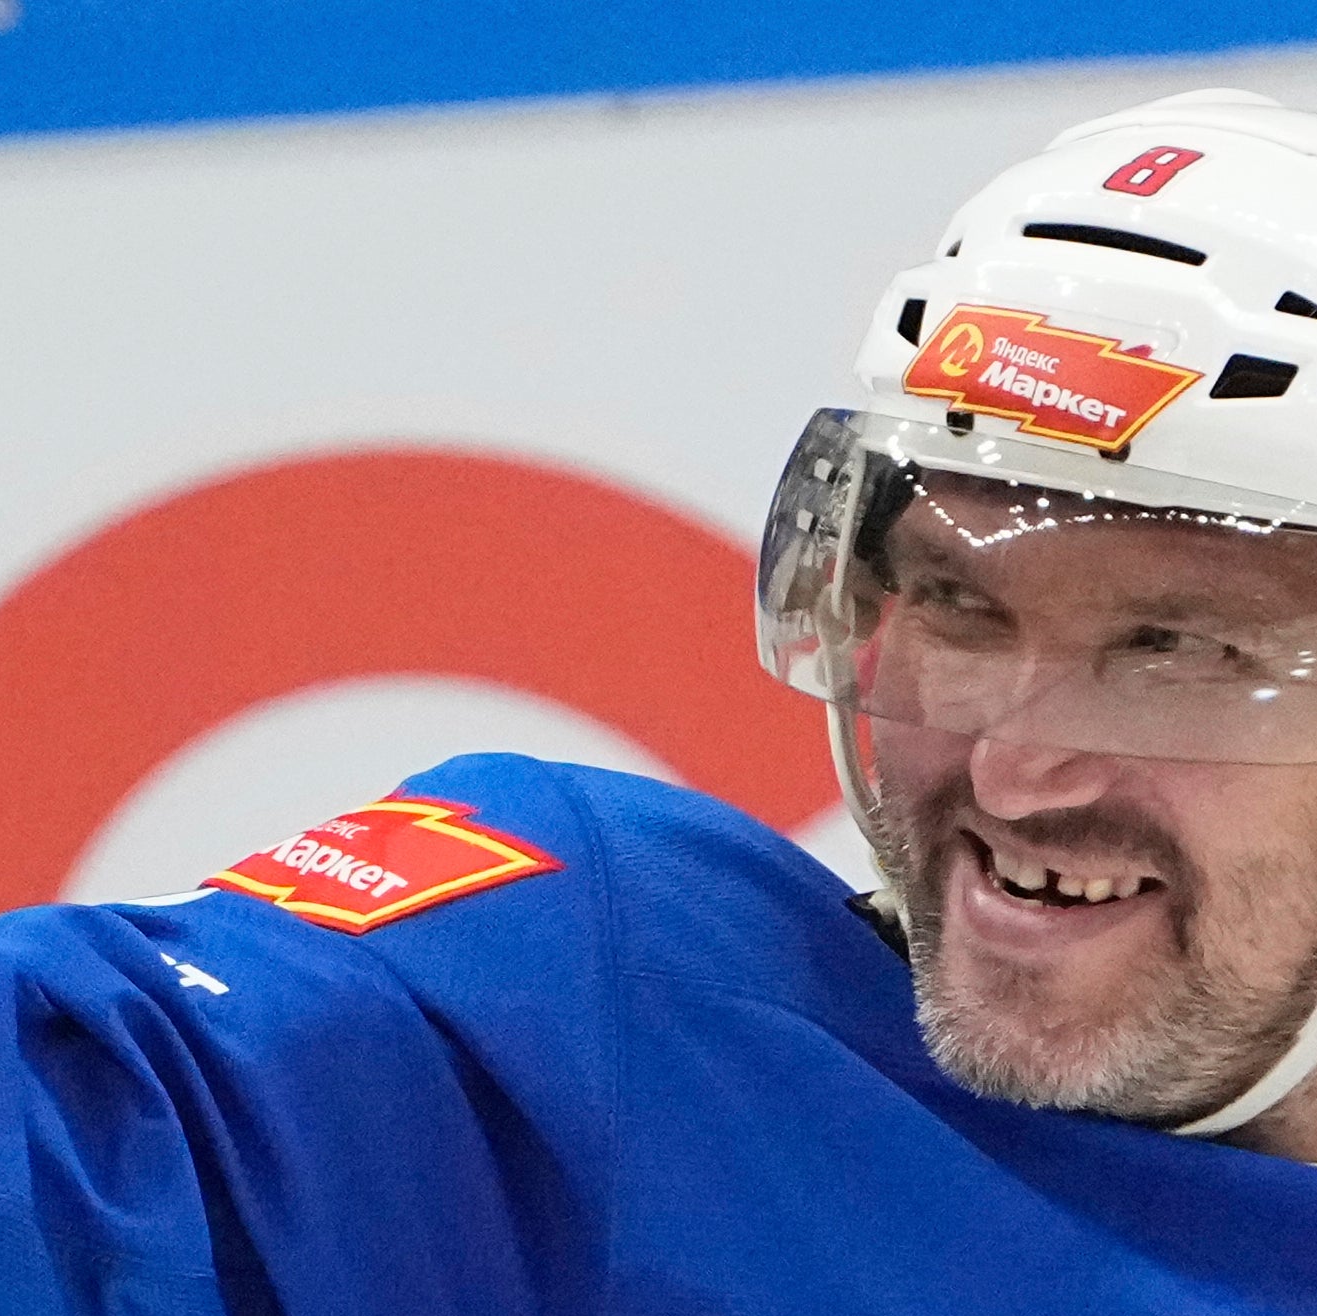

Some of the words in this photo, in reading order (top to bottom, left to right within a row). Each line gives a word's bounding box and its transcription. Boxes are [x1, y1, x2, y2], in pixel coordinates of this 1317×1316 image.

[1102, 145, 1205, 197] 8
[991, 336, 1061, 374] Яндекс
[978, 361, 1127, 428] Маркет
